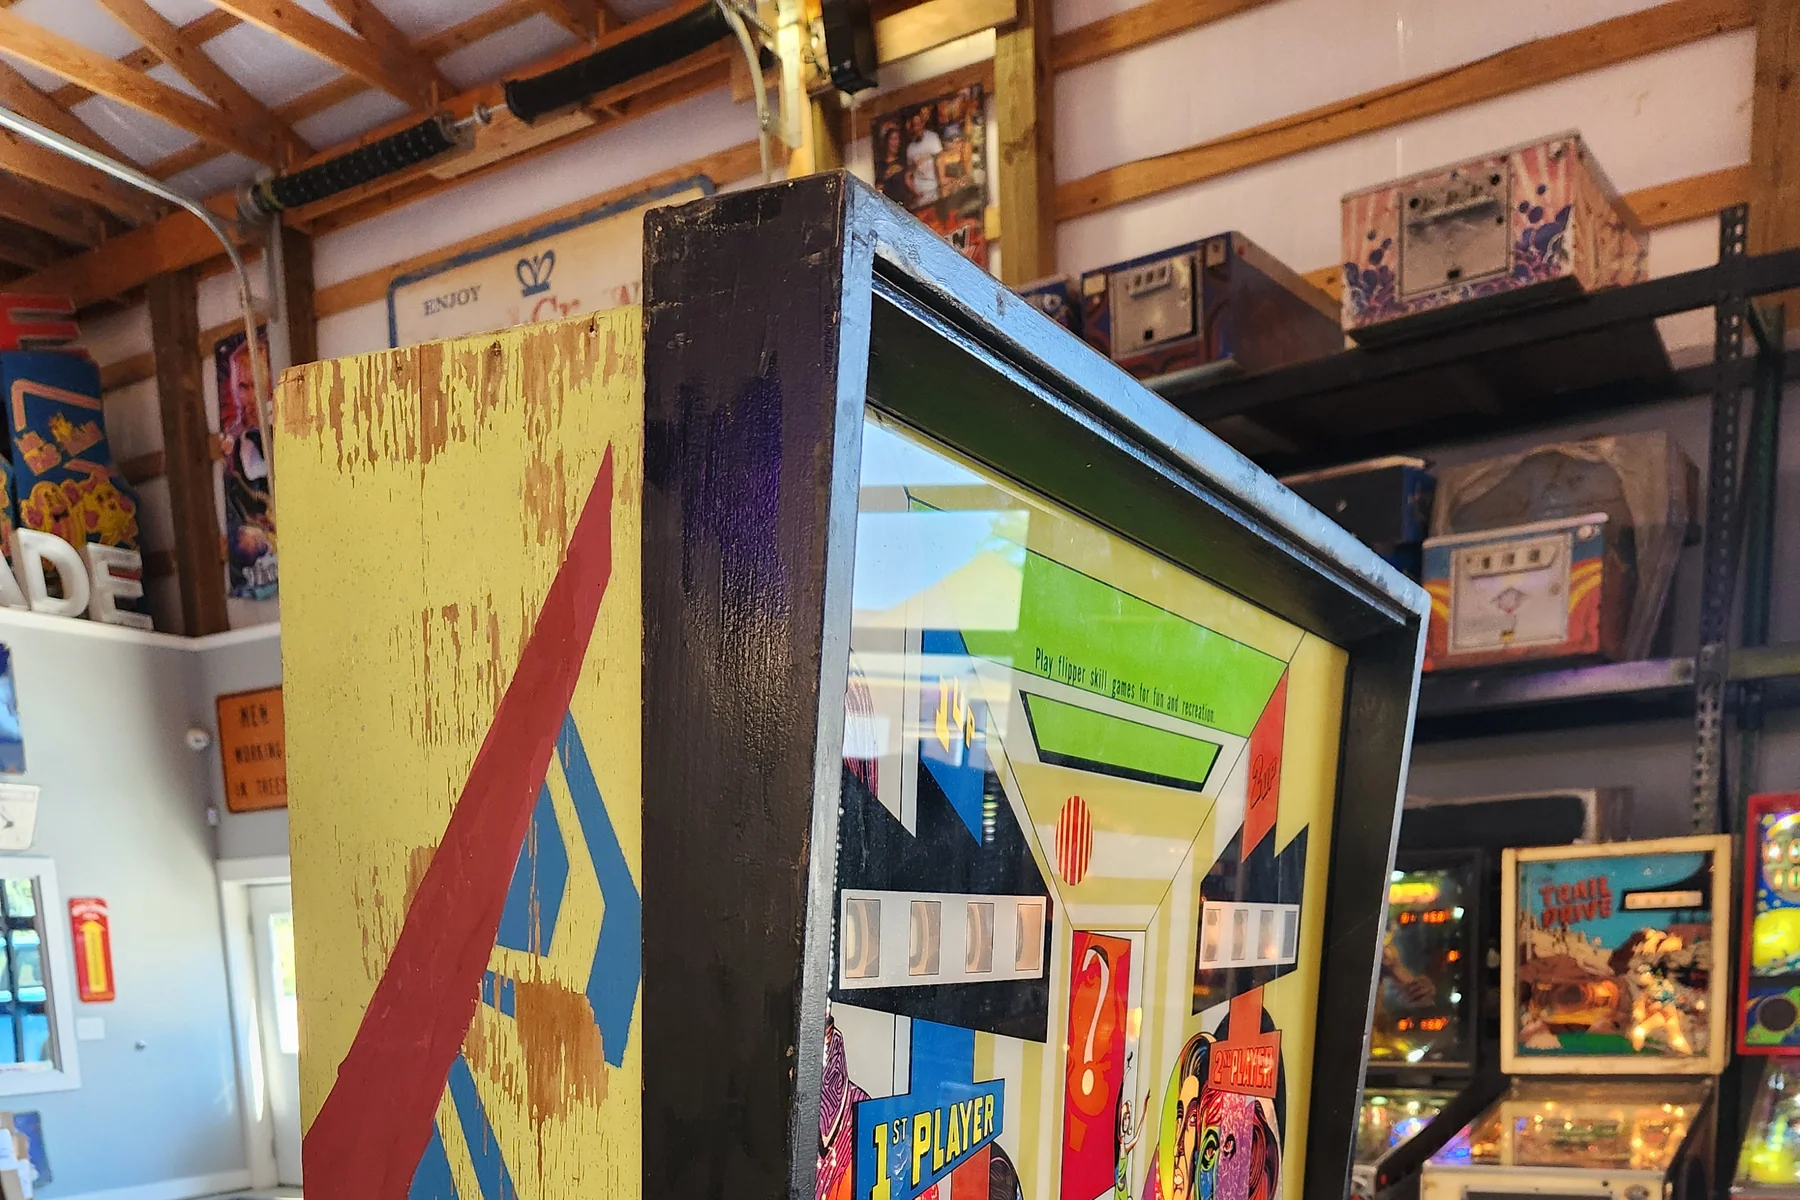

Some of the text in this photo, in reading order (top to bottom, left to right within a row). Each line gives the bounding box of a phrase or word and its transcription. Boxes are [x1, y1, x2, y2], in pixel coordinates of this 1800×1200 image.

[424, 284, 482, 316] ENJOY
[1035, 647, 1216, 724] Play flipper skill games for fun and recreation.
[1539, 876, 1611, 906] TRAIL
[1541, 896, 1613, 928] DRIVE
[1231, 1046, 1274, 1089] PLAYER
[911, 1093, 995, 1191] PLAYER
